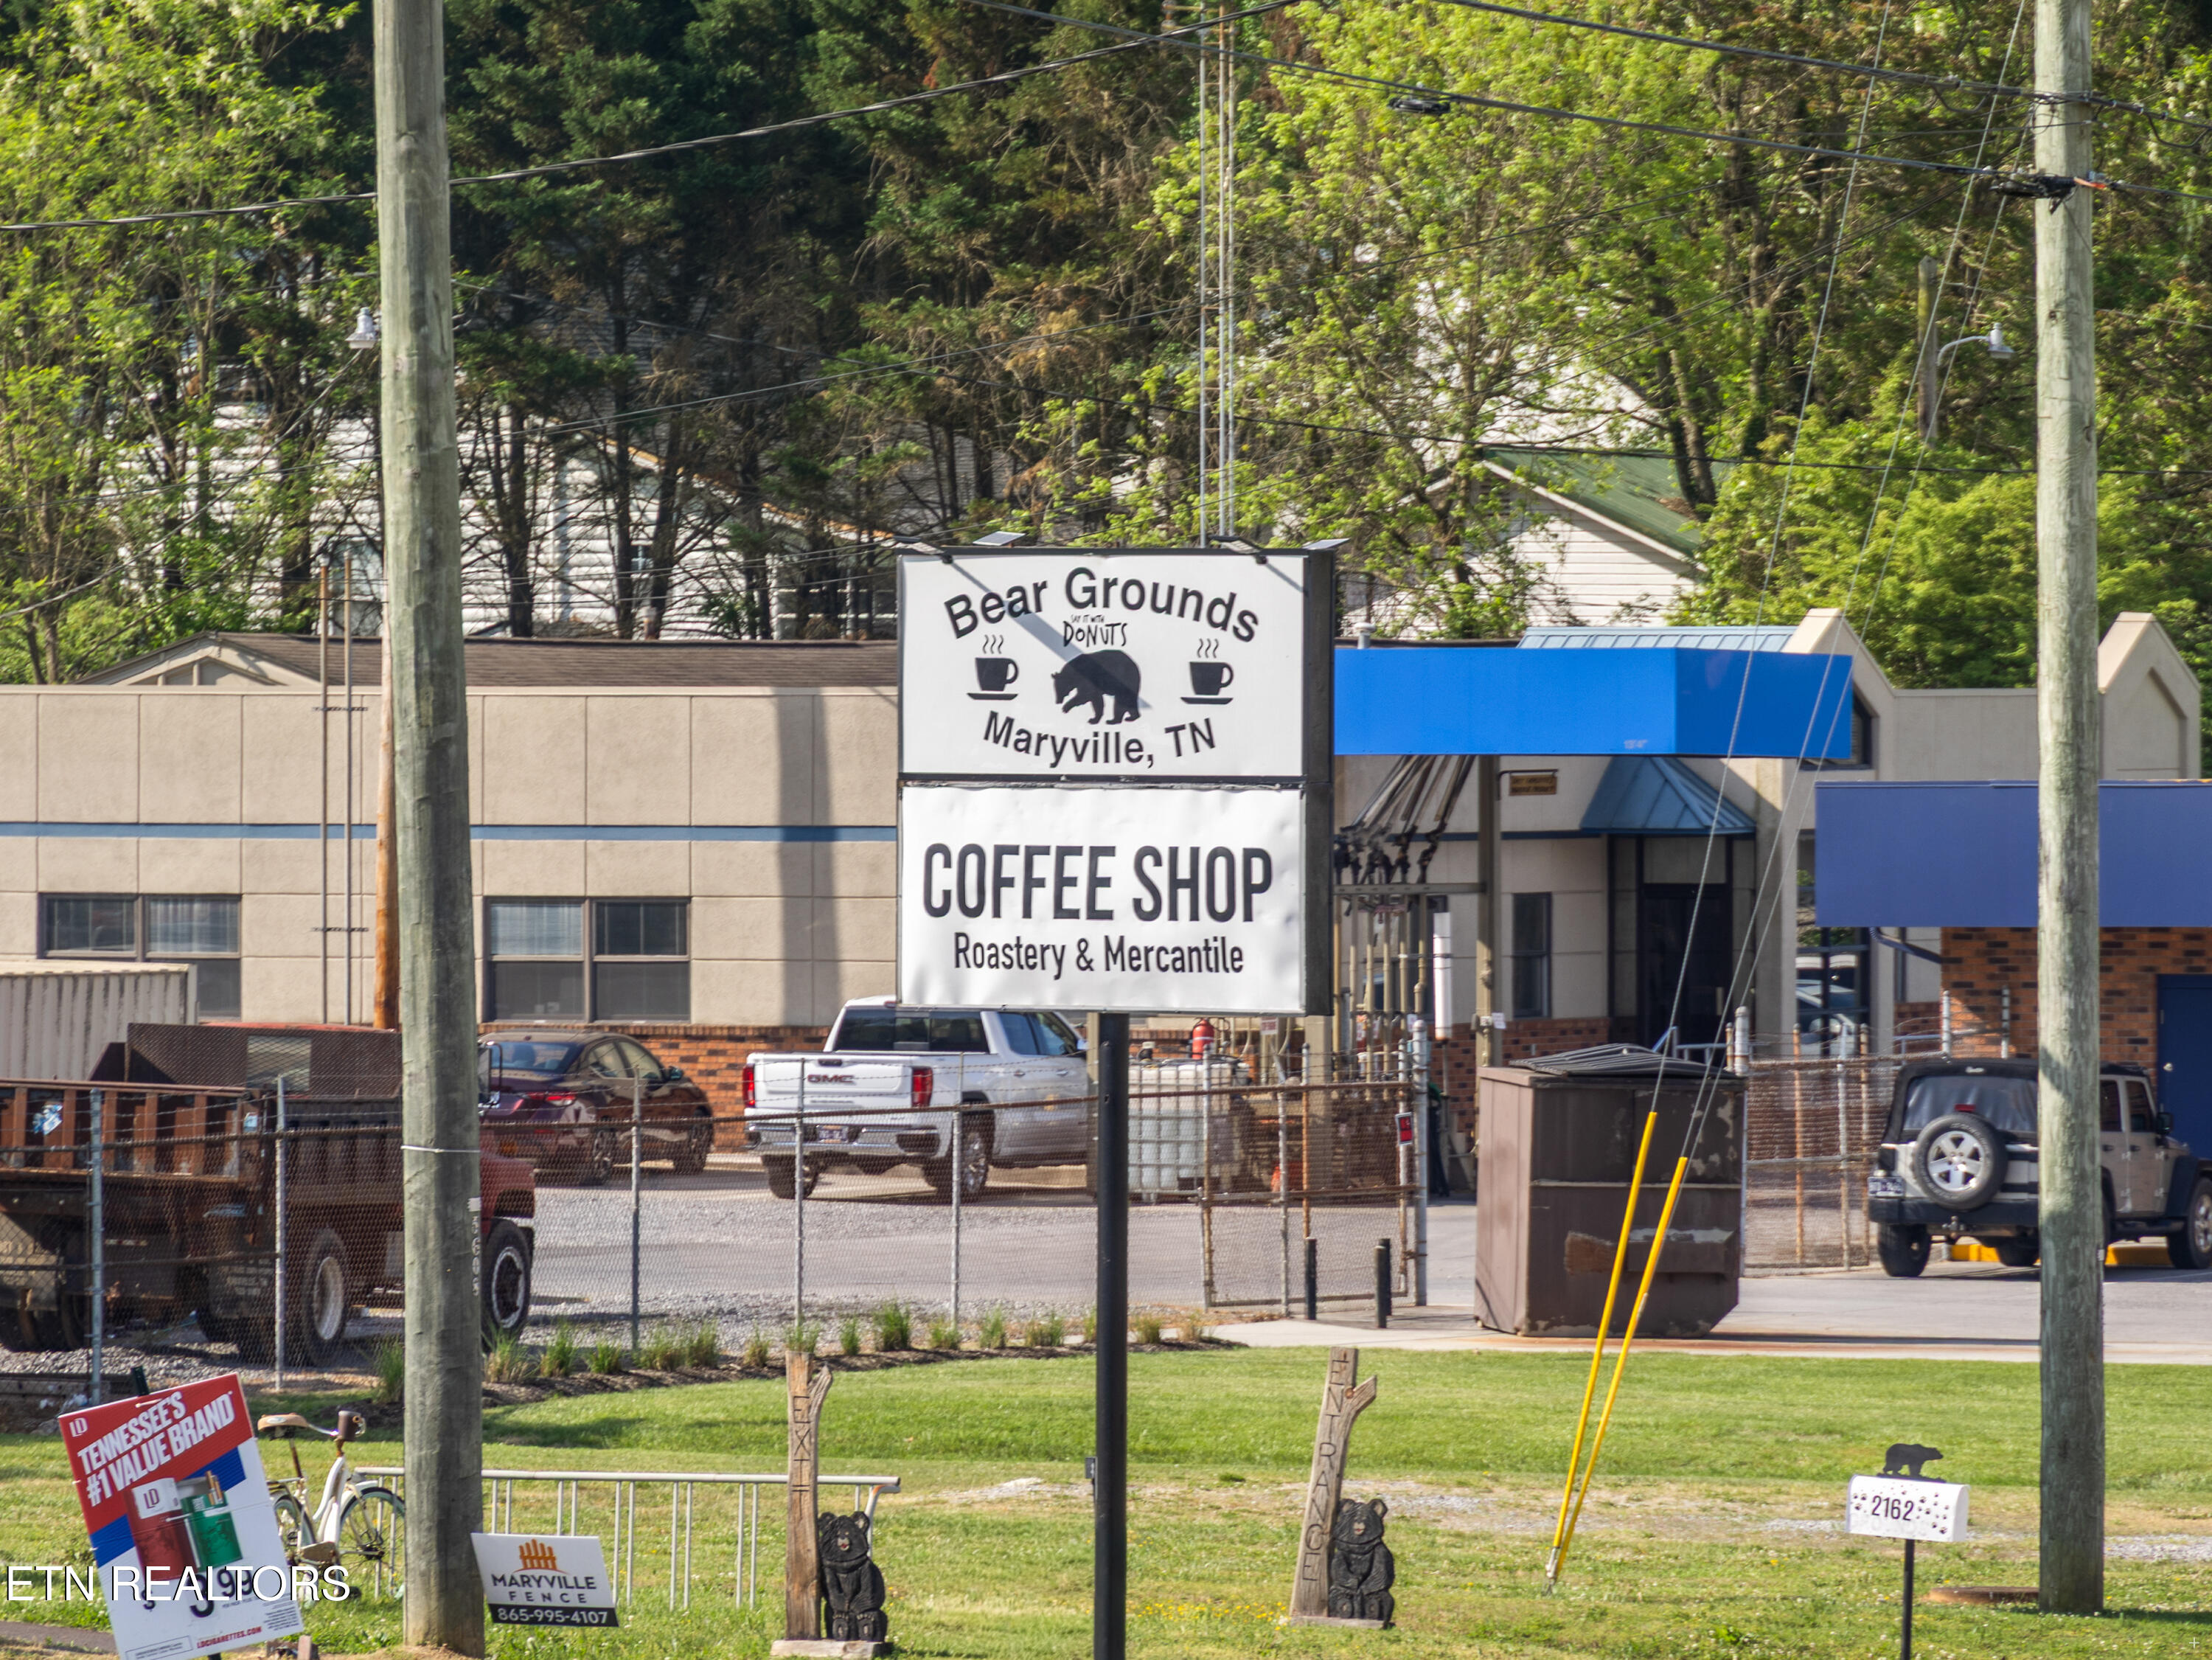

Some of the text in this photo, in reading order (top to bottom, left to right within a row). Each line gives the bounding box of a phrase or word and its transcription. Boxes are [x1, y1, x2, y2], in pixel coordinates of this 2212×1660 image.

[945, 567, 1259, 642] Bear Grounds
[983, 710, 1216, 768] Maryville, TN
[923, 843, 1273, 922] COFFEE SHOP
[954, 931, 1244, 980] Roastery & Mercantile
[807, 1074, 855, 1083] GMC
[69, 1417, 88, 1438] LD
[77, 1391, 186, 1476] TENNESSEE'S
[86, 1468, 113, 1507] #1
[108, 1431, 172, 1491] VALUE
[793, 1395, 810, 1519] EXIT
[1301, 1359, 1349, 1582] ENTRANCE
[144, 1488, 160, 1509] LD
[1871, 1495, 1915, 1521] 2162
[490, 1573, 597, 1590] MARYVILLE
[509, 1591, 587, 1603] FENCE
[497, 1608, 608, 1624] 865-995-4107
